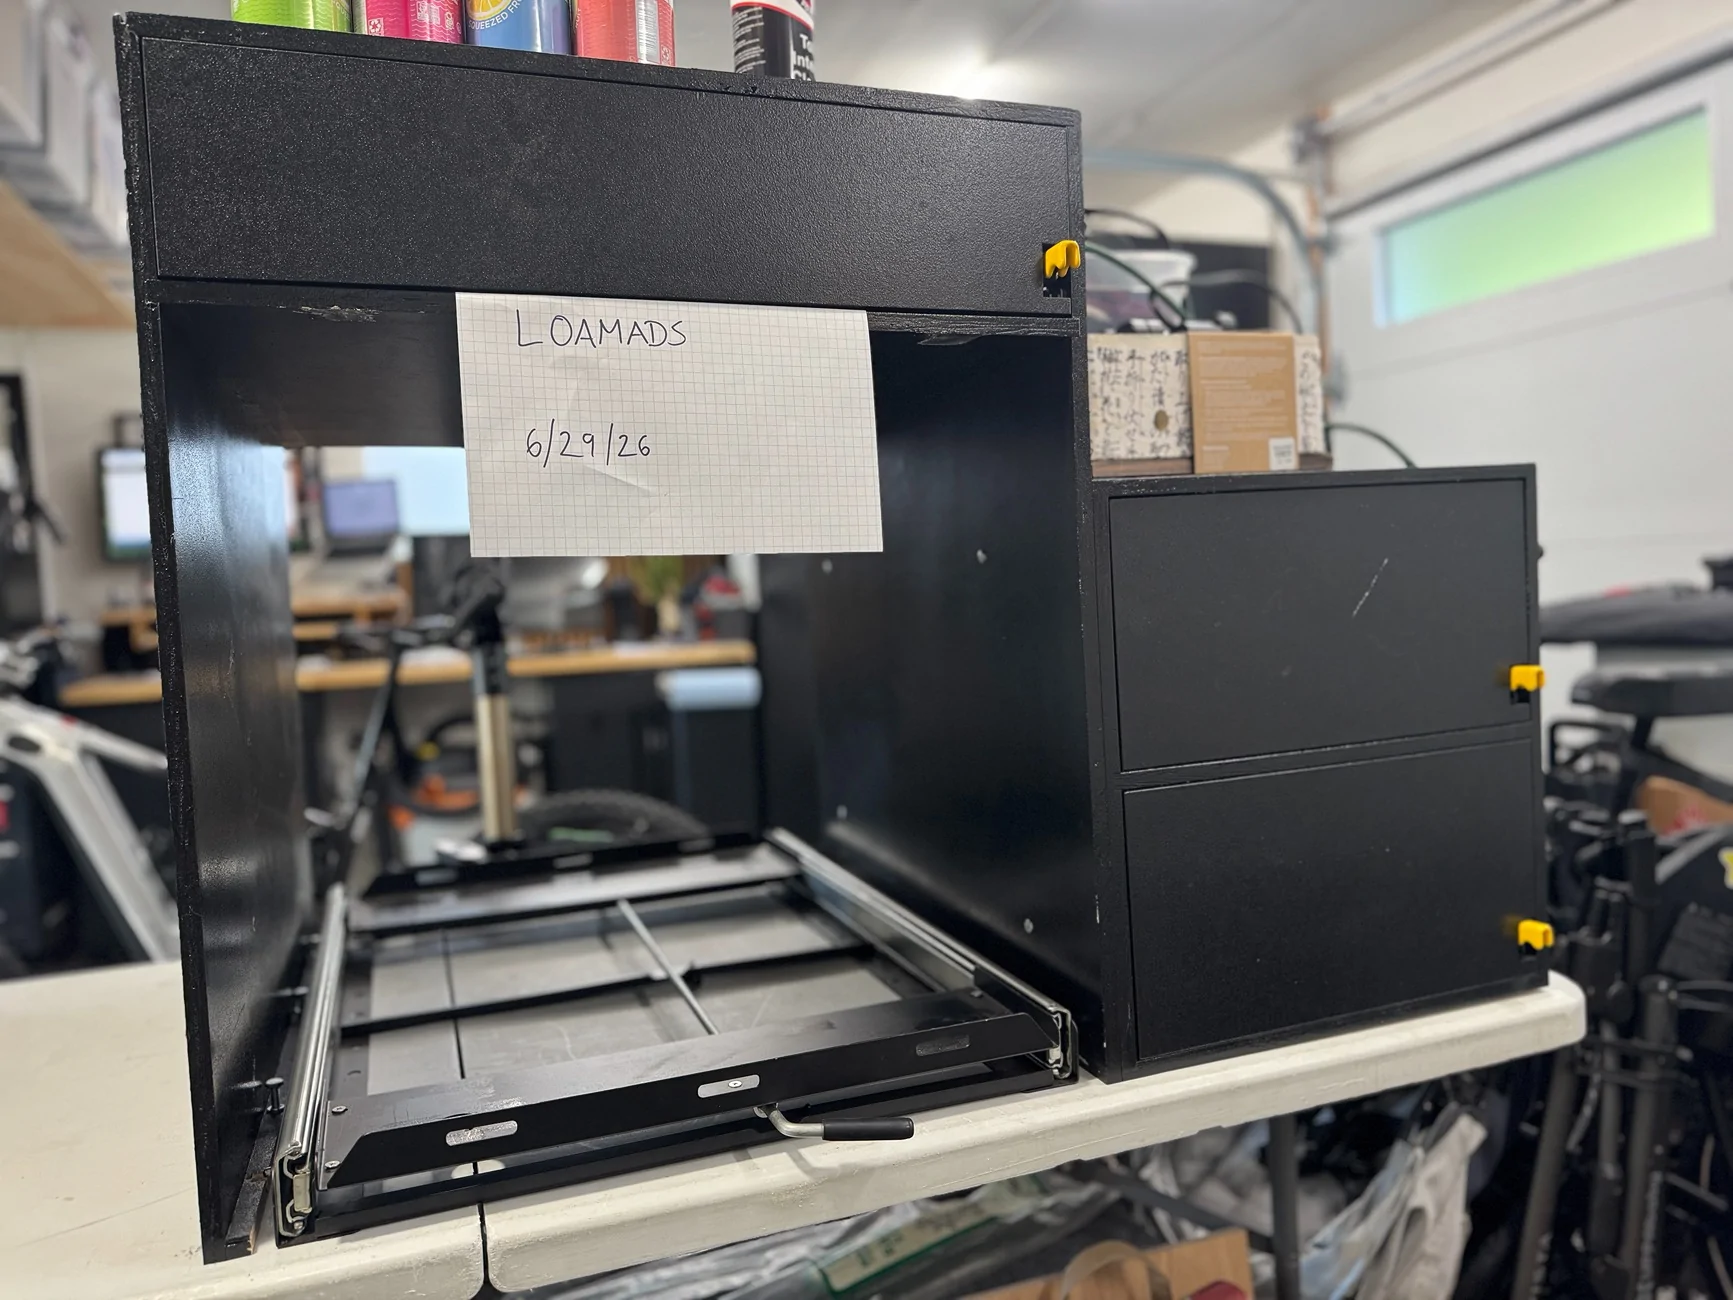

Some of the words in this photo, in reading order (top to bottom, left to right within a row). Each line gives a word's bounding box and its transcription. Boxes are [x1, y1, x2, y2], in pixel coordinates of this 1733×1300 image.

[468, 11, 509, 31] SQUEEZED
[507, 0, 522, 14] FR
[515, 308, 687, 349] LOAMADS
[526, 418, 651, 468] 6/29/26
